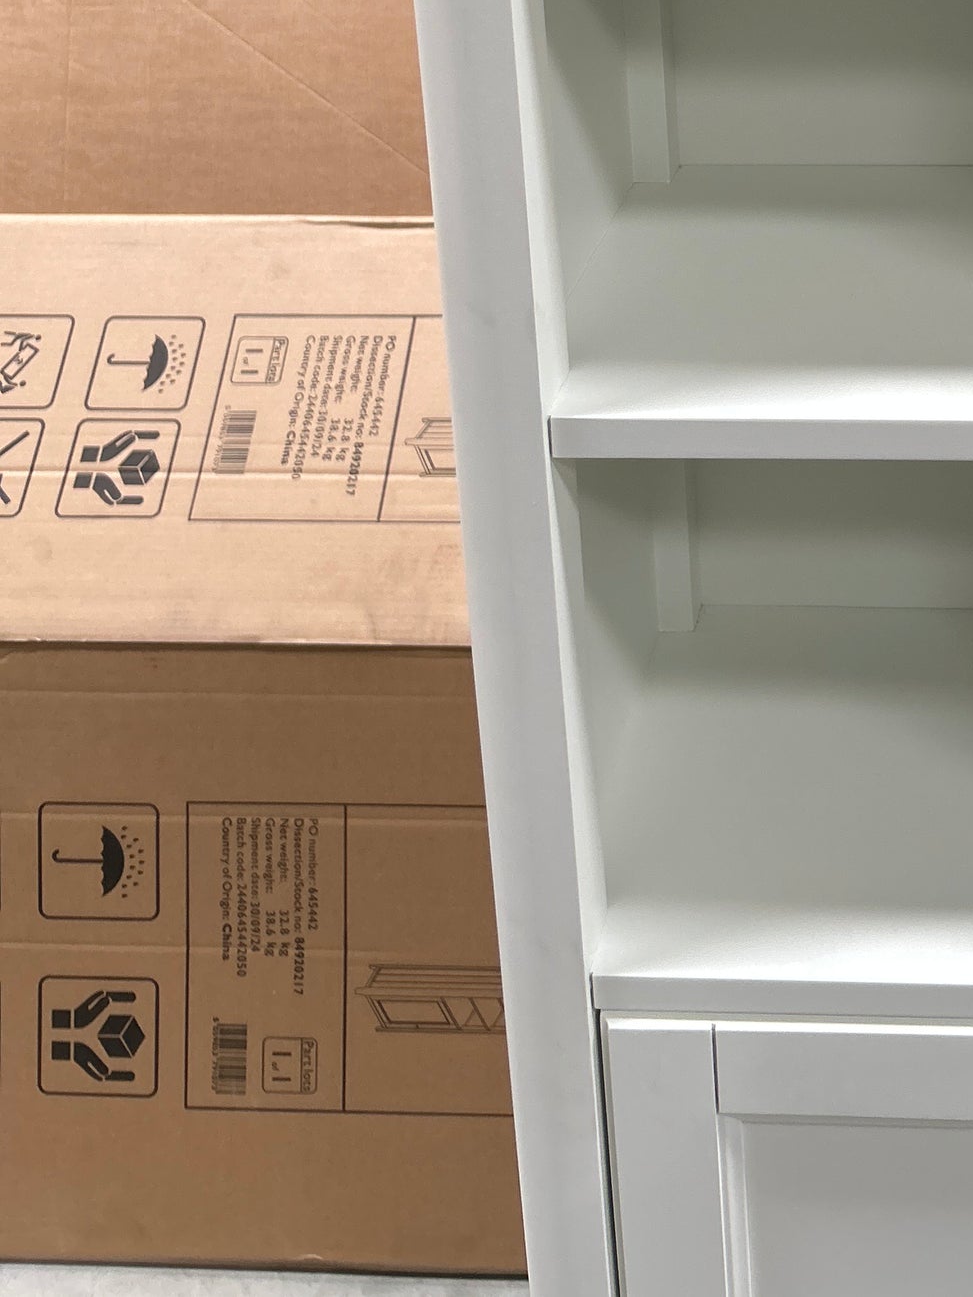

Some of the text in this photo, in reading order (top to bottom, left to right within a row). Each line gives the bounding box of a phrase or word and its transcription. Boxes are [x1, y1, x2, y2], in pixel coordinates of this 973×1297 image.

[280, 336, 316, 466] Country of Origin: China
[310, 365, 322, 393] code:
[316, 336, 329, 363] Batch
[320, 383, 333, 408] date:
[322, 336, 355, 462] Gross weight: 38.6 kg
[323, 336, 342, 382] Shipment
[335, 336, 369, 462] Net weight: 32.8 kg
[368, 336, 396, 436] PO number: 645442
[345, 336, 382, 496] Dissection/Stock no: 84920217
[220, 817, 232, 961] Country of Origin: China
[236, 818, 247, 977] Batch code: 2440645442050
[249, 817, 261, 952] Shipment date: 30/09/24
[263, 818, 276, 957] Gross weight: 38.6 kg
[277, 818, 290, 957] Net weight: 32.8 kg
[294, 818, 304, 995] Dissection/Stock no: 84920217
[307, 818, 319, 931] PO number: 645442
[303, 1041, 314, 1093] Part lots
